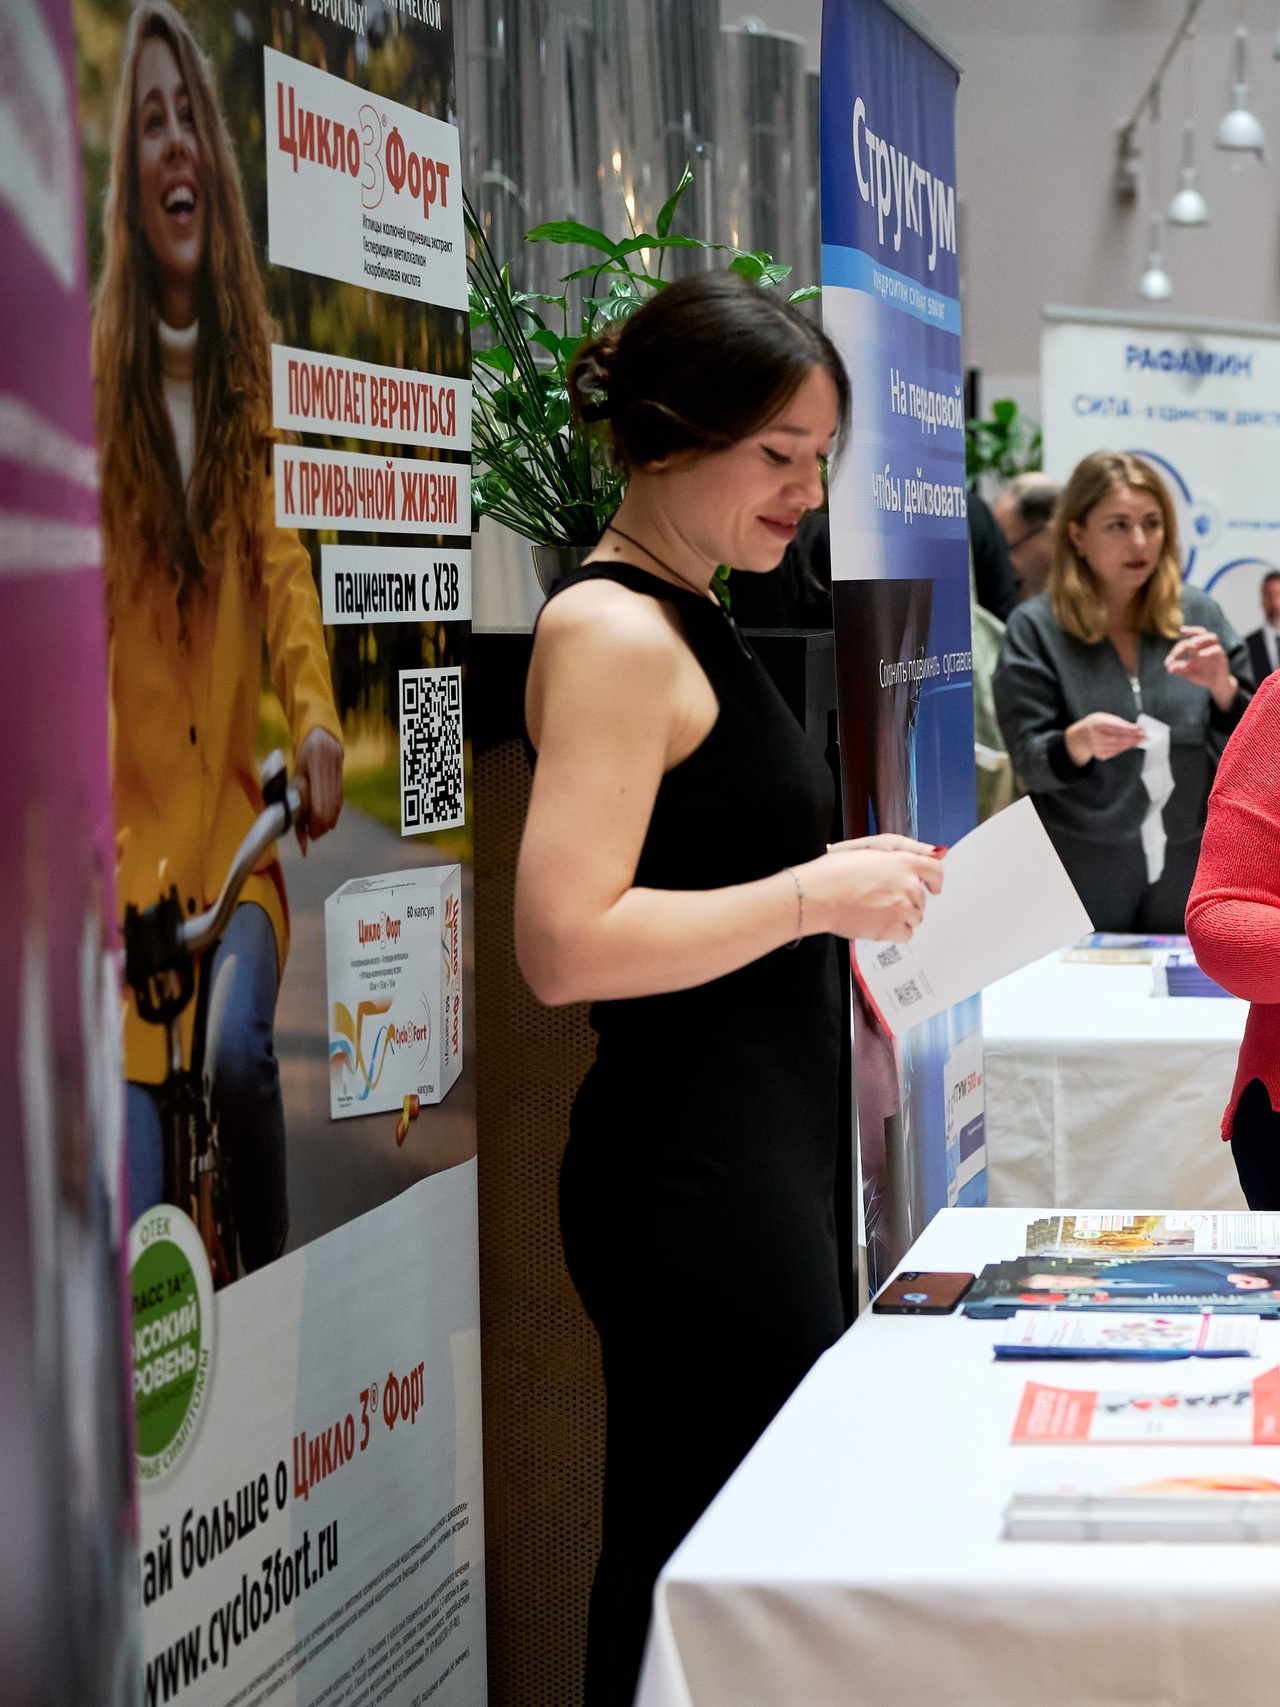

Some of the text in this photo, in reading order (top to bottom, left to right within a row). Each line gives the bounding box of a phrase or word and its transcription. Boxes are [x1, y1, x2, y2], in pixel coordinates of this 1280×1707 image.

[277, 81, 361, 178] Цикло
[385, 127, 450, 219] Форт
[853, 97, 957, 271] Структум
[382, 224, 407, 240] колючей
[431, 237, 453, 254] экстракт
[363, 258, 421, 287] Аскорбиновая кислота
[288, 359, 456, 437] ПОМОГАЕТ ВЕРНУТЬСЯ
[890, 368, 907, 416] На
[283, 459, 458, 524] К ПРИВЫЧНОЙ ЖИЗНИ
[334, 562, 459, 620] пациентам с ХЗВ
[358, 919, 380, 948] Цикло
[385, 915, 401, 944] Форт
[406, 905, 435, 919] 60 капсул
[140, 1216, 171, 1245] ОТЕК
[134, 1342, 197, 1395] РОВЕНЬ
[144, 1525, 173, 1607] ай
[181, 1473, 269, 1579] больше
[275, 1460, 287, 1511] о
[293, 1413, 355, 1501] Цикло
[382, 1361, 425, 1431] Форт
